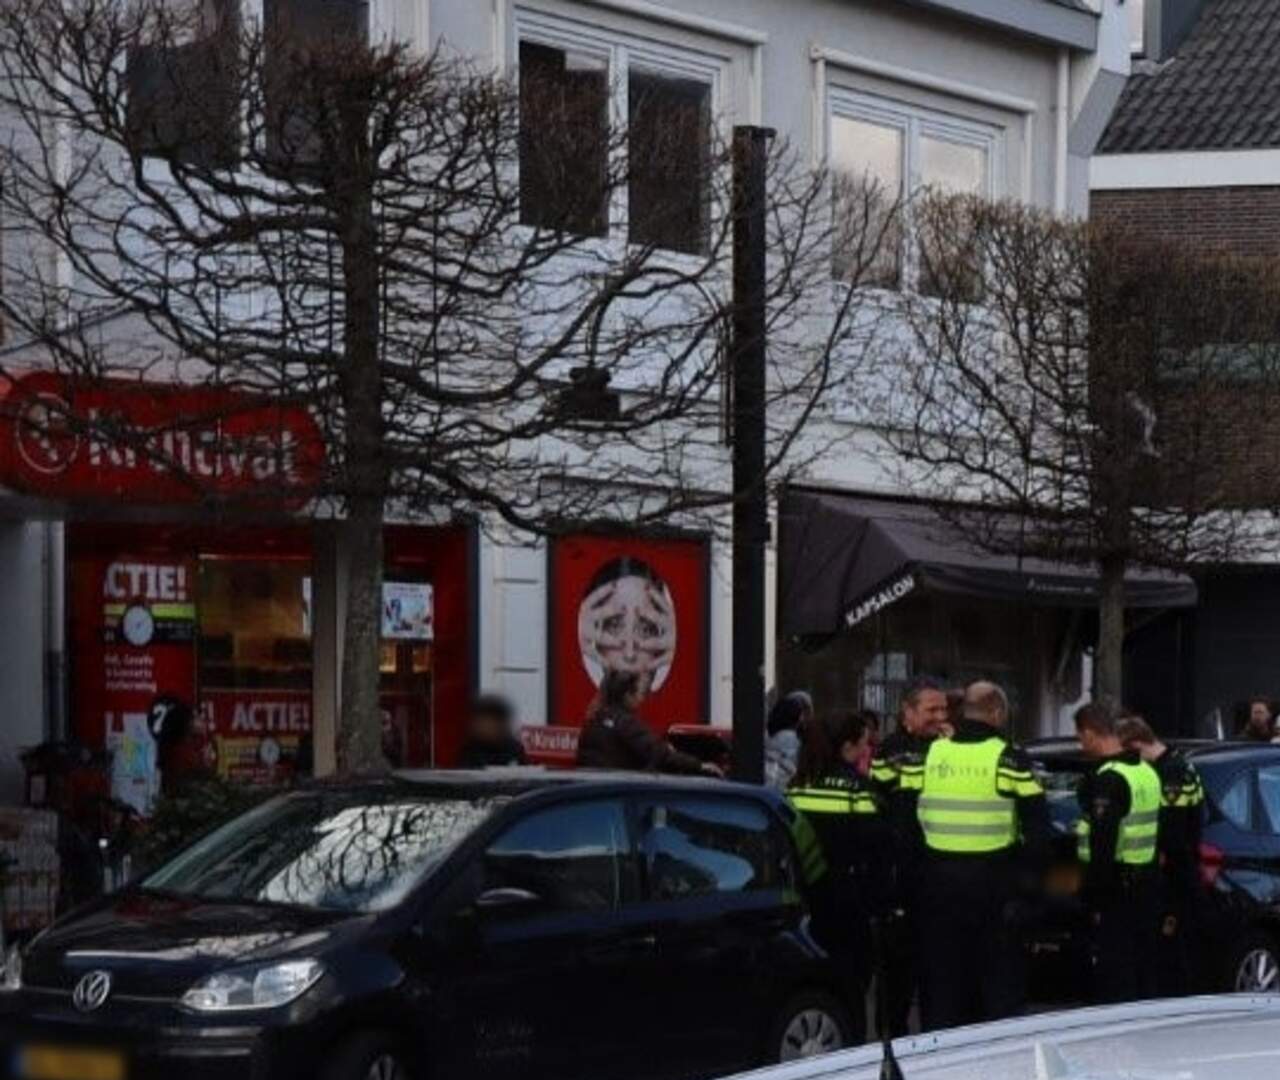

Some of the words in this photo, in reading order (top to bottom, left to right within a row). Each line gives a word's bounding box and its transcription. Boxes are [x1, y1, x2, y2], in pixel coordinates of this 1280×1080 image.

[103, 562, 187, 601] CTIE!
[845, 574, 915, 626] KAPSALON
[231, 702, 309, 731] ACTIE!
